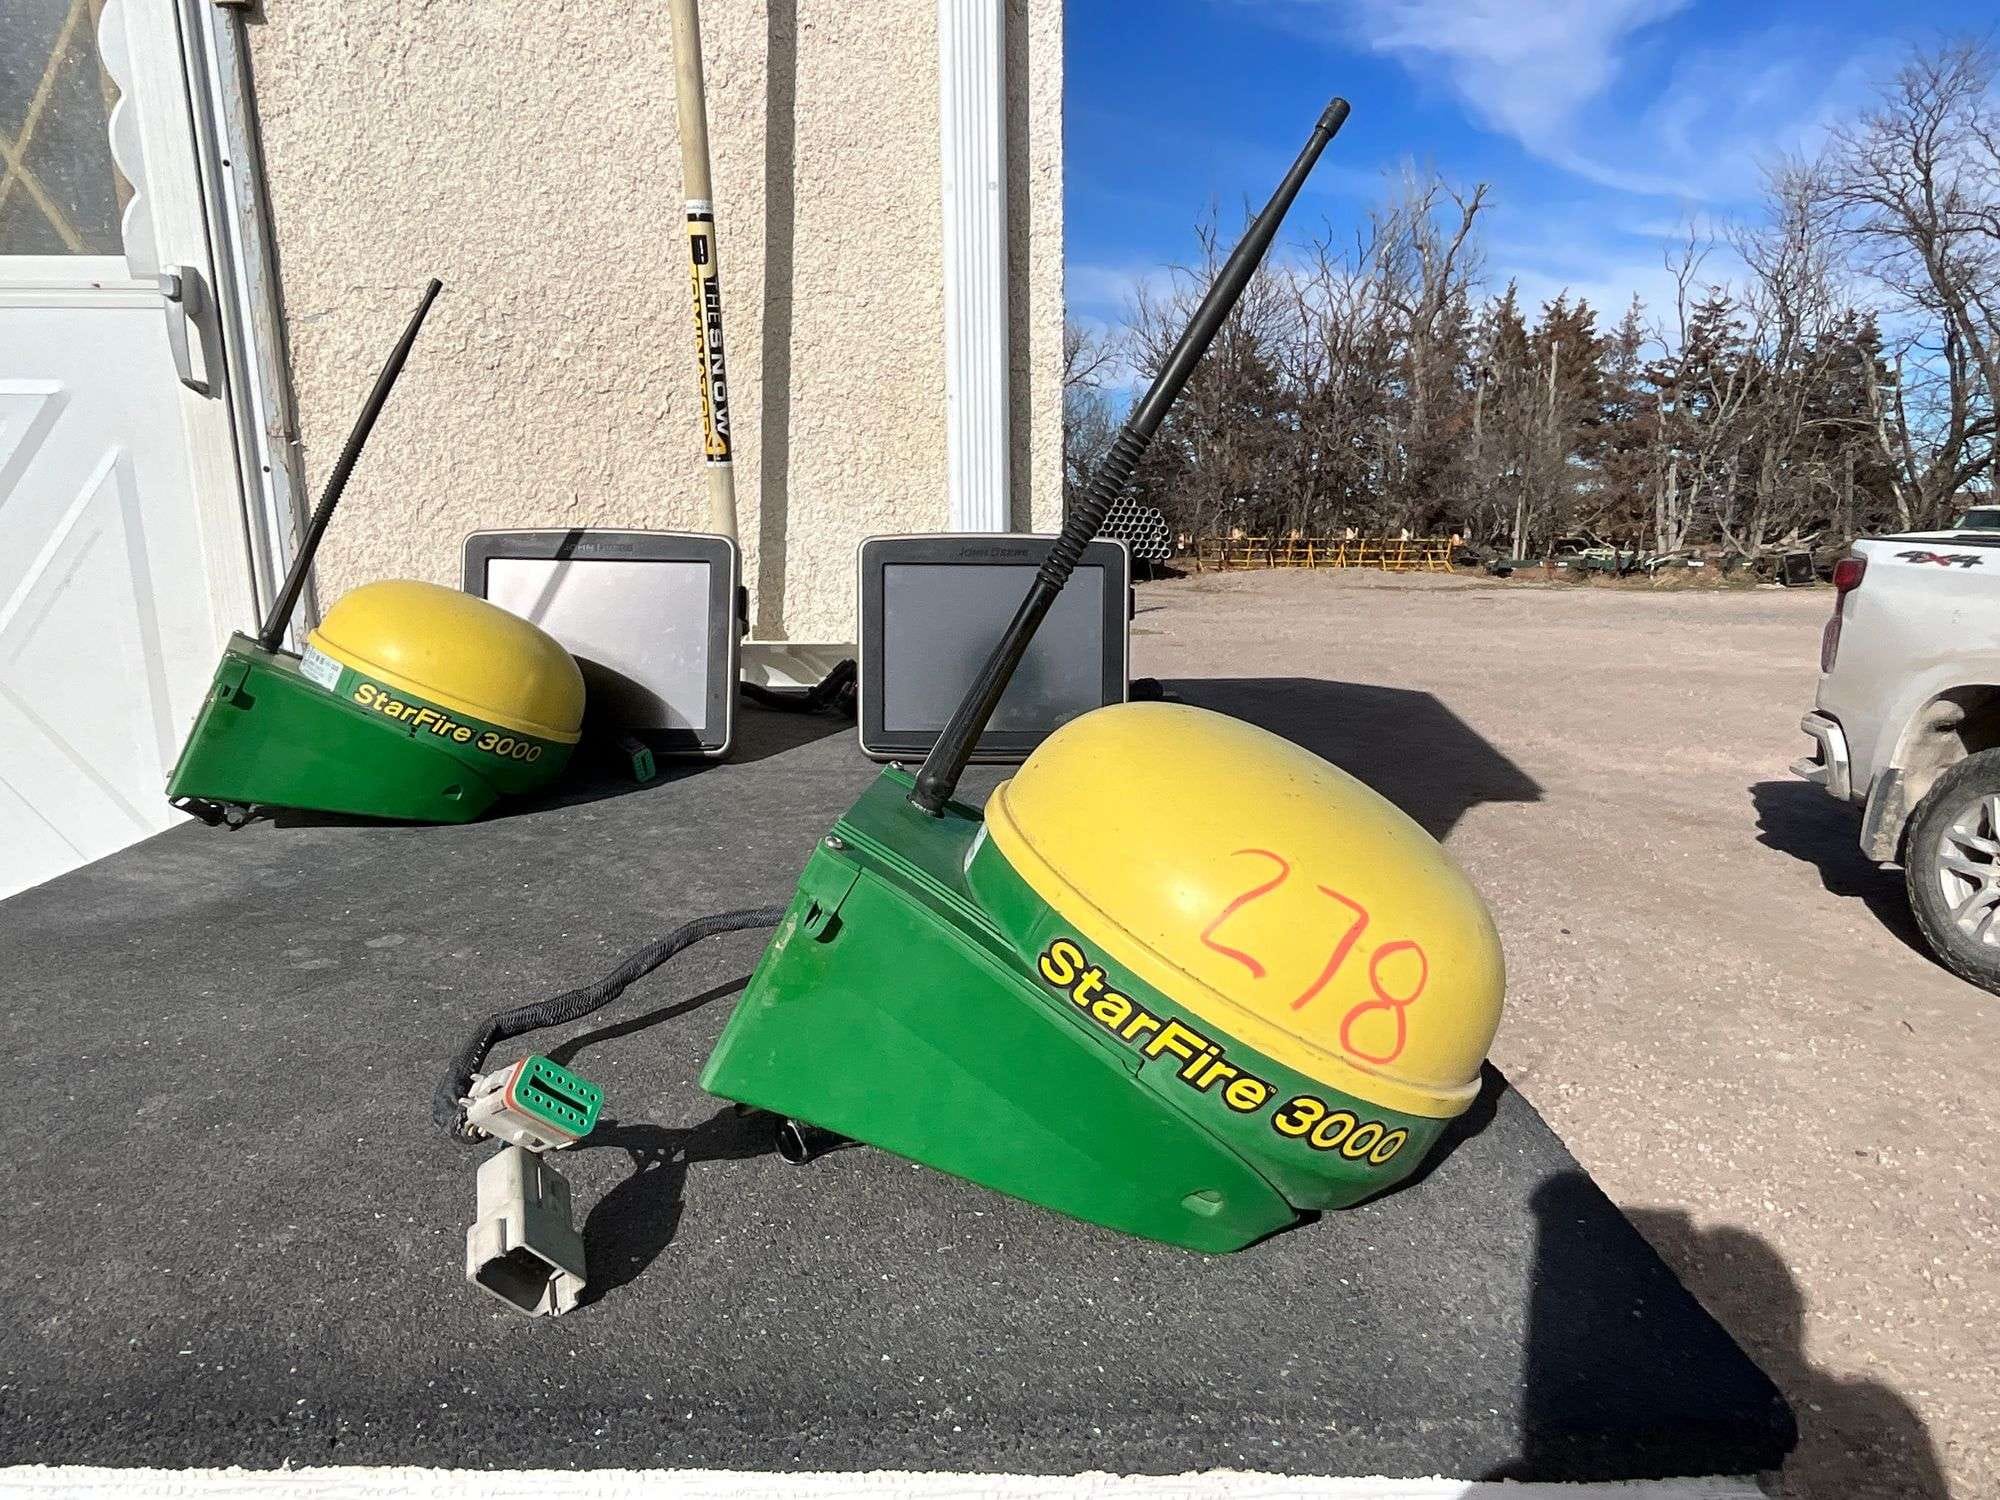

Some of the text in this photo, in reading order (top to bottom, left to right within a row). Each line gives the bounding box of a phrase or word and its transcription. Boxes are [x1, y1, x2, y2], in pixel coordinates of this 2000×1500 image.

[704, 280, 729, 436] THE SNOW
[353, 683, 542, 763] StarFire 3000
[1200, 848, 1428, 1065] 278
[1271, 1095, 1409, 1167] 3000
